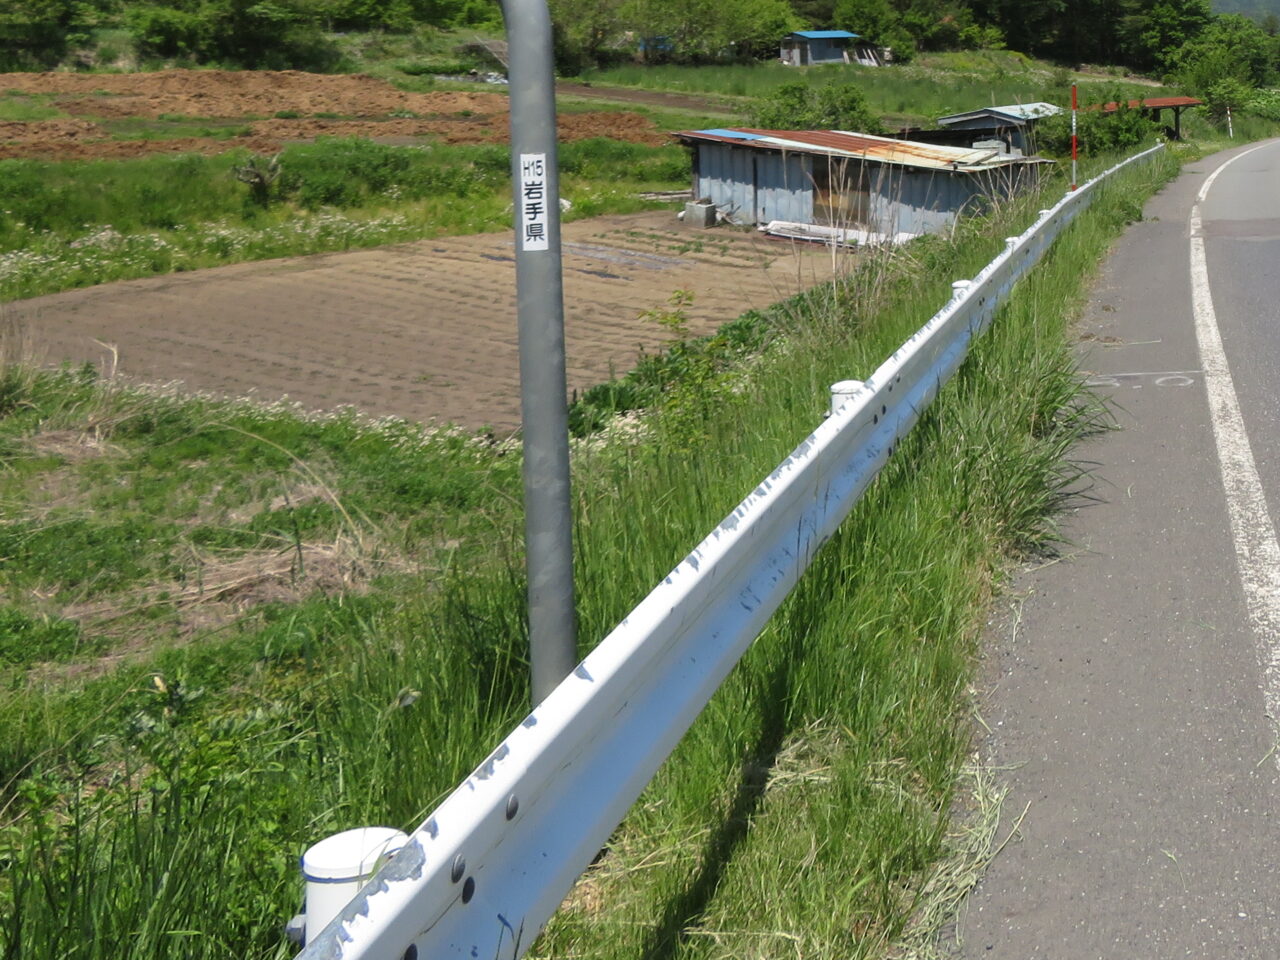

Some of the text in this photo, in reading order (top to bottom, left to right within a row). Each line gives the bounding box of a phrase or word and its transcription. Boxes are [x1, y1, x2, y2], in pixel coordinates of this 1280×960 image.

[523, 160, 544, 177] H15
[523, 180, 545, 242] 岩手県
